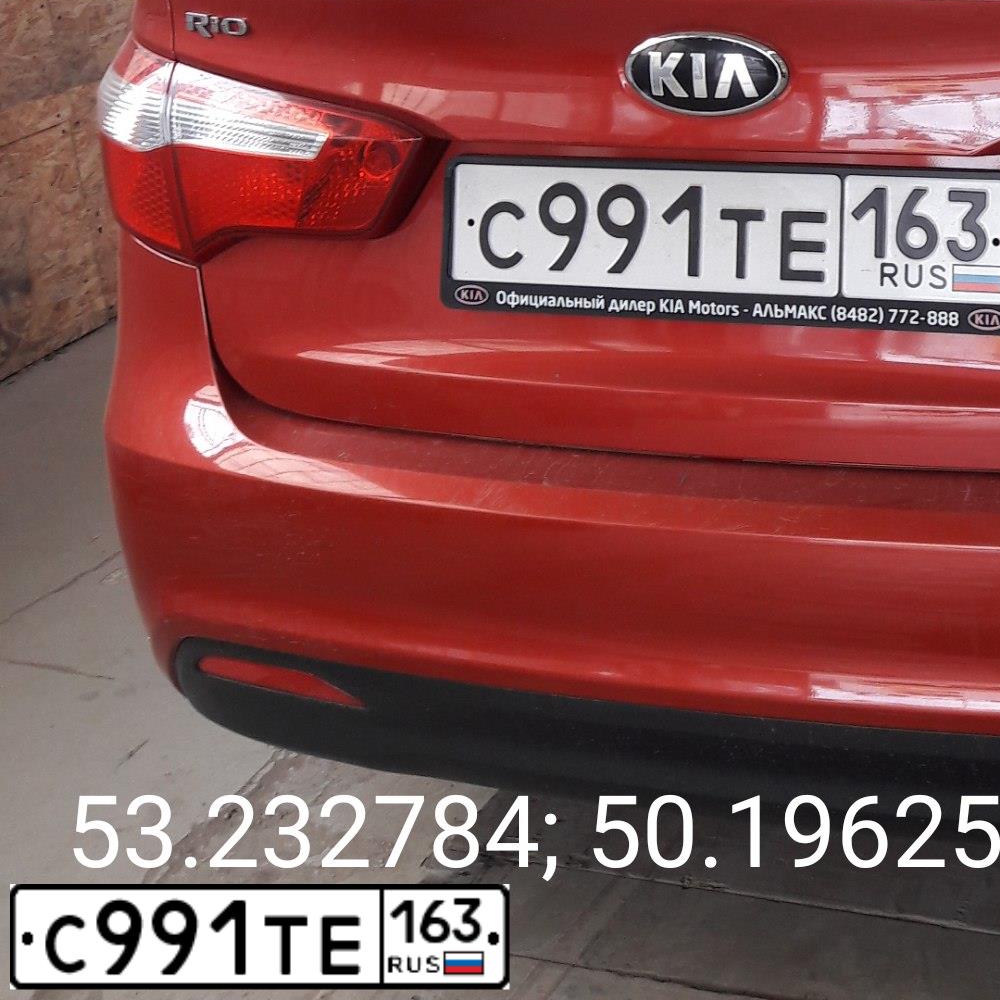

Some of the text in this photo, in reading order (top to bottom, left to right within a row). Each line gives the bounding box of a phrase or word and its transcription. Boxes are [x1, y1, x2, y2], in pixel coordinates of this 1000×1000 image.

[648, 51, 759, 99] KIA
[479, 182, 986, 282] С991ТЕ 163
[880, 263, 946, 289] RUS
[460, 289, 483, 302] KIA
[496, 290, 605, 310] Официальный
[608, 298, 656, 315] дилер
[659, 300, 684, 314] KIA
[689, 300, 739, 316] Motors
[752, 303, 827, 321] АЛЬМАКС
[831, 306, 884, 325] (8482)
[888, 309, 959, 327] 772-888
[974, 313, 999, 326] KIA
